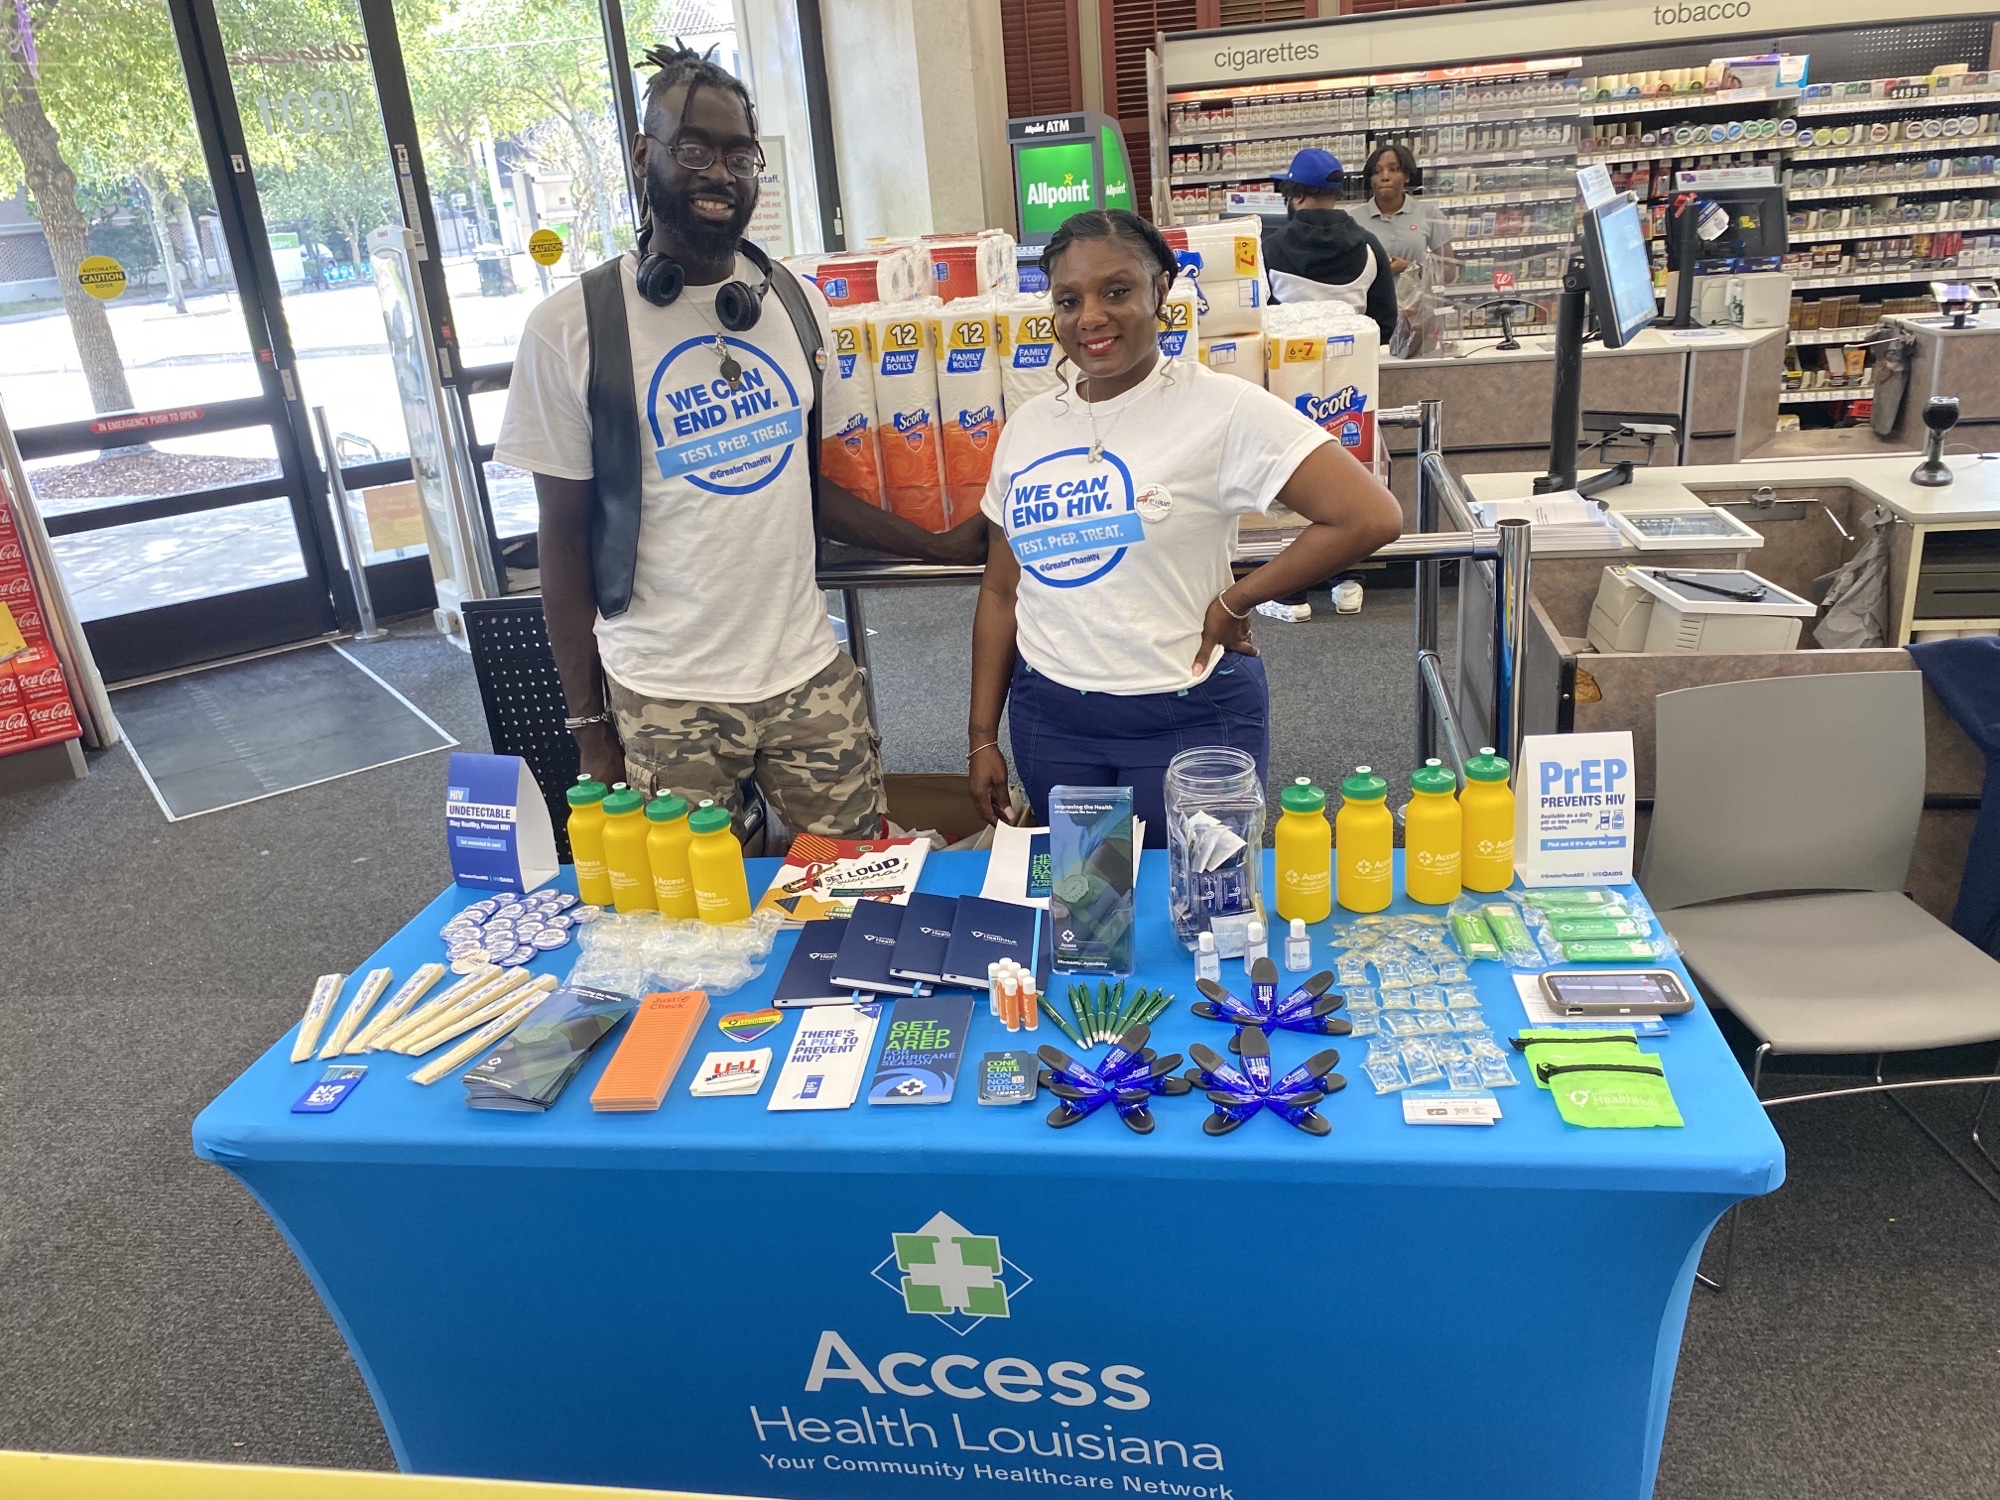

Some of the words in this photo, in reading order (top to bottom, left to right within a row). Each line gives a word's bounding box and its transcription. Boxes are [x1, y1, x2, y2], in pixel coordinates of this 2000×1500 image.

[1653, 1, 1751, 26] tobacco
[1214, 41, 1320, 71] cigarettes
[1024, 123, 1045, 134] Allpoint
[1046, 119, 1070, 133] ATM
[1027, 176, 1090, 209] Allpoint
[1105, 182, 1126, 197] Allpoint
[530, 243, 563, 252] CAUTION
[82, 265, 119, 273] AUTOMATIC
[82, 272, 124, 283] CAUTION
[1164, 303, 1188, 326] 12
[890, 324, 918, 346] 12
[957, 322, 985, 344] 12
[1025, 317, 1054, 339] 12
[831, 328, 855, 351] 12
[951, 352, 982, 361] FAMILY
[1019, 347, 1050, 357] FAMILY
[1289, 347, 1296, 356] 6
[1303, 341, 1314, 357] 7
[885, 354, 915, 364] FAMILY
[952, 360, 979, 369] ROLLS
[1019, 355, 1047, 364] ROLLS
[886, 363, 913, 371] ROLLS
[665, 384, 712, 413] WE
[710, 367, 765, 400] CAN
[1306, 385, 1354, 422] Scott
[673, 404, 728, 437] END
[730, 388, 780, 420] HIV.
[899, 408, 924, 430] Scott
[964, 406, 990, 428] Scott
[97, 423, 107, 432] IN
[107, 417, 149, 430] EMERGENCY
[150, 414, 169, 424] PUSH
[169, 413, 179, 422] TO
[180, 410, 198, 420] OPEN
[678, 444, 718, 466] TEST.
[717, 434, 751, 455] PrEP.
[750, 421, 793, 444] TREAT.
[709, 455, 773, 481] @GreaterThanHIV
[1015, 484, 1053, 506] WE
[1055, 475, 1109, 499] CAN
[1012, 501, 1059, 529] END
[1067, 491, 1113, 518] HIV.
[1018, 539, 1047, 556] TEST.
[1049, 533, 1079, 549] PrEP.
[1079, 524, 1124, 542] TREAT.
[1039, 552, 1100, 572] @GreaterThanHIV
[1540, 758, 1628, 795] PrEP
[449, 789, 464, 801] HIV
[1541, 795, 1602, 808] PREVENTS
[1605, 793, 1626, 806] HIV
[449, 805, 511, 819] UNDETECTABLE
[1054, 803, 1083, 811] Improving
[449, 819, 460, 828] Stay
[461, 820, 480, 830] Healthy,
[480, 822, 500, 831] Prevent
[1607, 839, 1620, 847] you!
[576, 859, 600, 867] Access
[825, 873, 843, 882] GET
[847, 857, 900, 878] LOUD
[658, 877, 685, 885] Access
[652, 996, 677, 1004] Just
[892, 1020, 938, 1031] GET
[796, 1039, 807, 1047] A
[810, 1038, 838, 1046] PILL
[842, 1036, 859, 1045] TO
[801, 1029, 856, 1039] THERE'S
[889, 1029, 951, 1041] PREP
[794, 1044, 857, 1055] PREVENT
[885, 1039, 950, 1051] ARED
[791, 1054, 823, 1063] HIV?
[882, 1052, 957, 1061] HURRICANE
[714, 1059, 756, 1074] U=U
[987, 1065, 1020, 1073] CTATE
[986, 1084, 1026, 1092] OTROS
[805, 1330, 1150, 1411] Access
[749, 1406, 939, 1448] Health
[952, 1413, 1225, 1471] Louisiana
[760, 1453, 816, 1471] Your
[823, 1454, 965, 1480] Community
[974, 1463, 1114, 1489] Healthcare
[1123, 1475, 1235, 1500] Network
